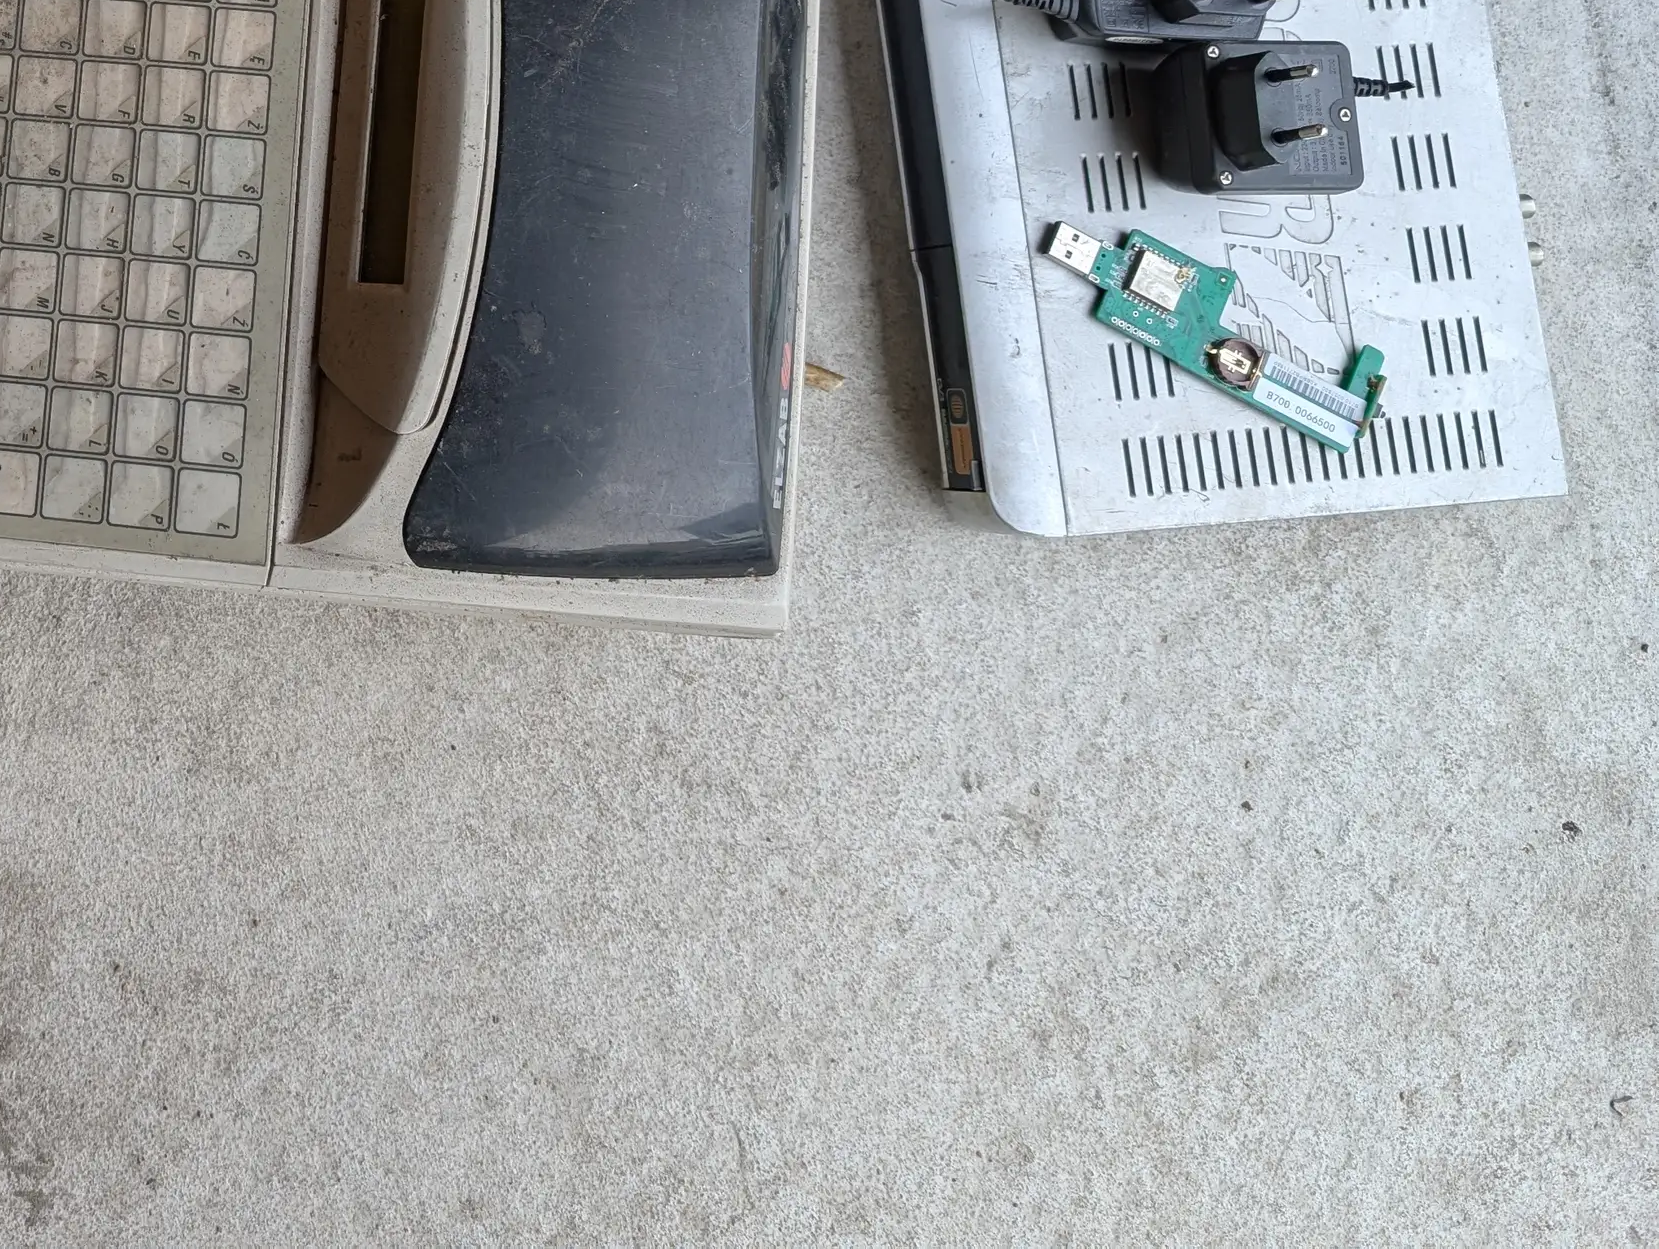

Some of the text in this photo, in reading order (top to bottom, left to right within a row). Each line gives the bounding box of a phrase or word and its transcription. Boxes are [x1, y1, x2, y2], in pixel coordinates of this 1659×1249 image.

[60, 40, 72, 50] C
[124, 45, 136, 55] D
[188, 51, 200, 60] E
[54, 104, 67, 113] V
[118, 110, 130, 119] F
[183, 113, 195, 124] R
[49, 167, 61, 177] B
[112, 173, 125, 183] G
[178, 179, 191, 189] T
[42, 232, 55, 243] N
[106, 238, 119, 249] H
[173, 243, 185, 253] Y
[37, 296, 49, 309] M
[101, 304, 114, 313] J
[167, 309, 180, 320] U
[95, 370, 108, 381] K
[773, 398, 788, 509] ELZAB
[151, 514, 163, 524] P
